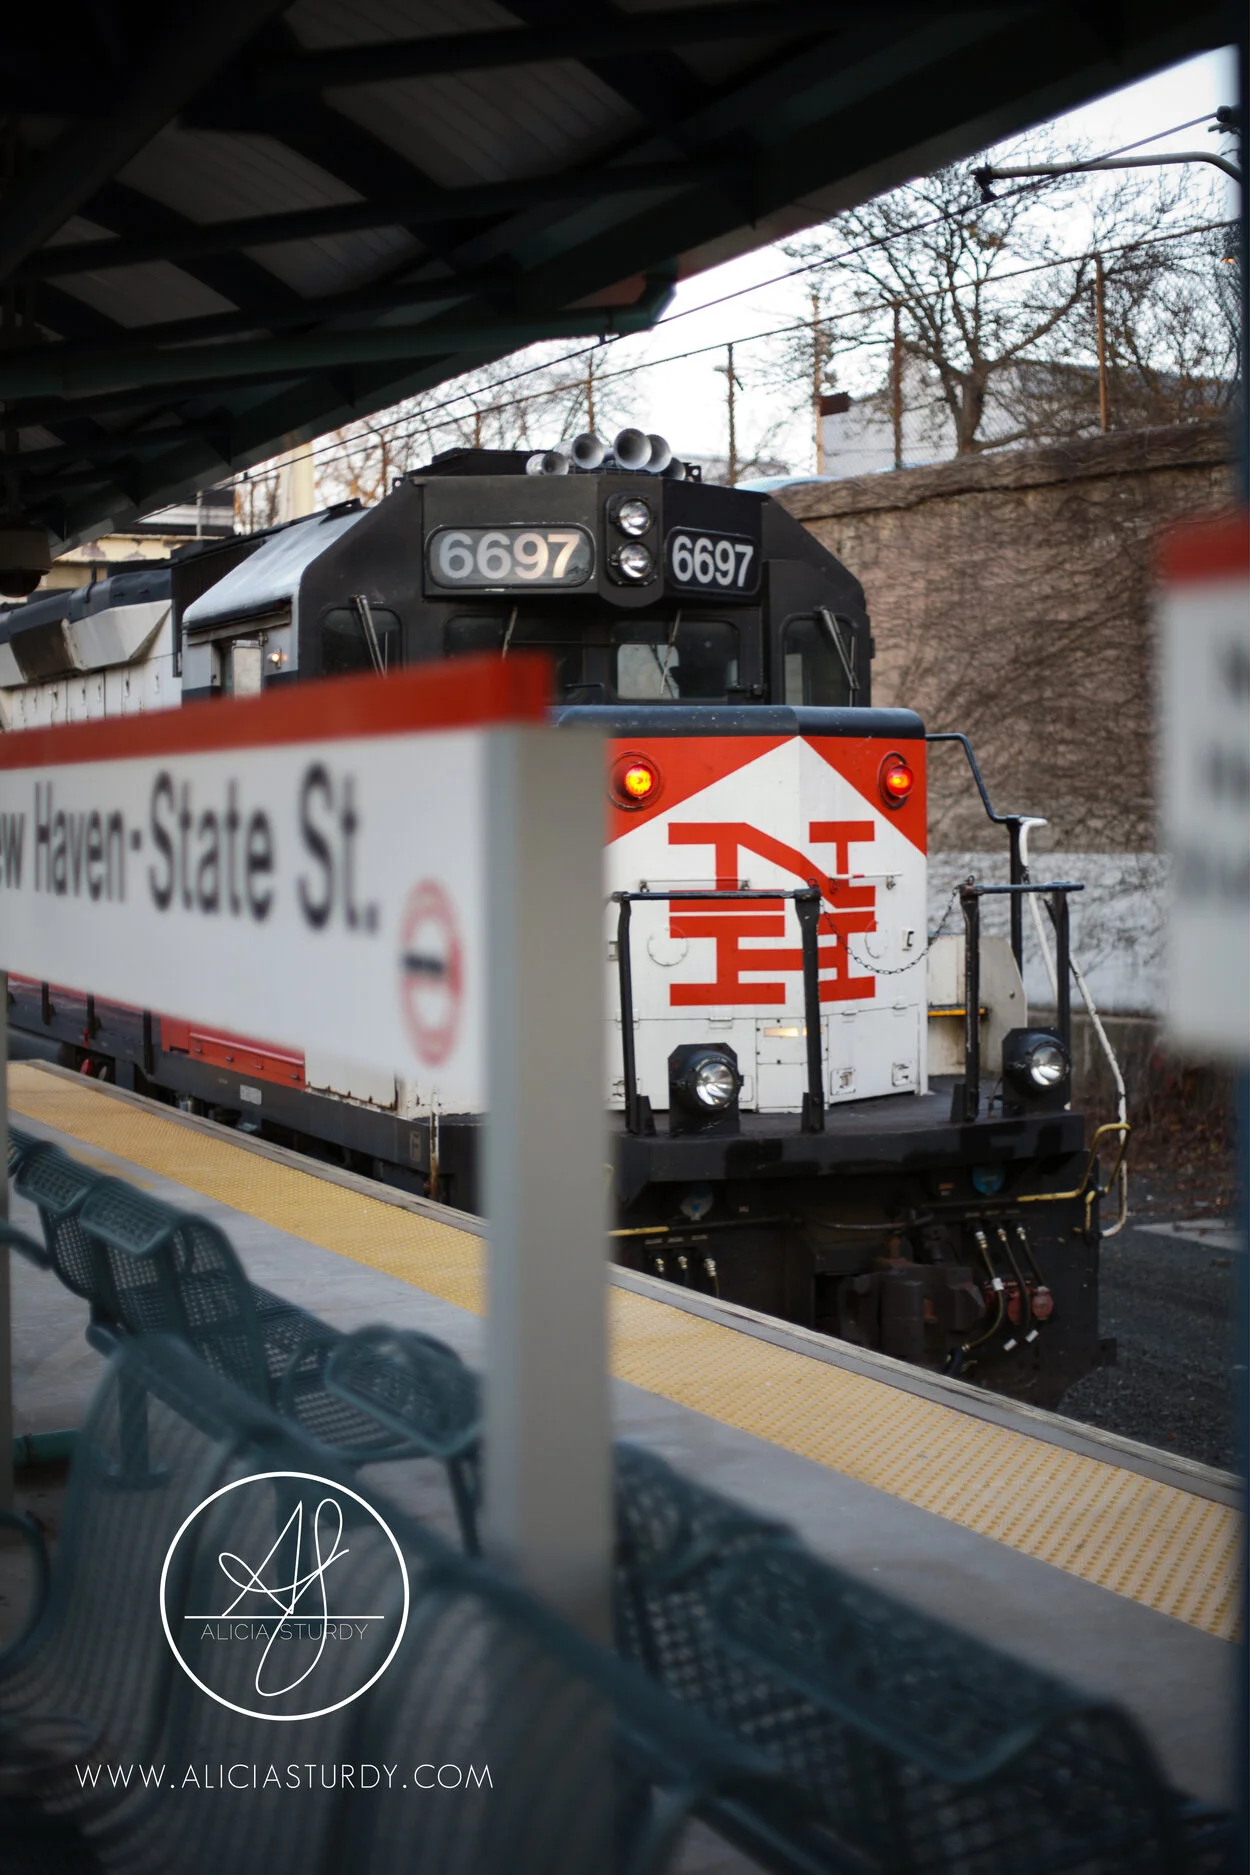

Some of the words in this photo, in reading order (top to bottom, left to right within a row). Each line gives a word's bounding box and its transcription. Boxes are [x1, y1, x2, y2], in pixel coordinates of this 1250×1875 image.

[438, 532, 581, 580] 6697
[671, 534, 755, 588] 6697
[297, 760, 381, 936] St.
